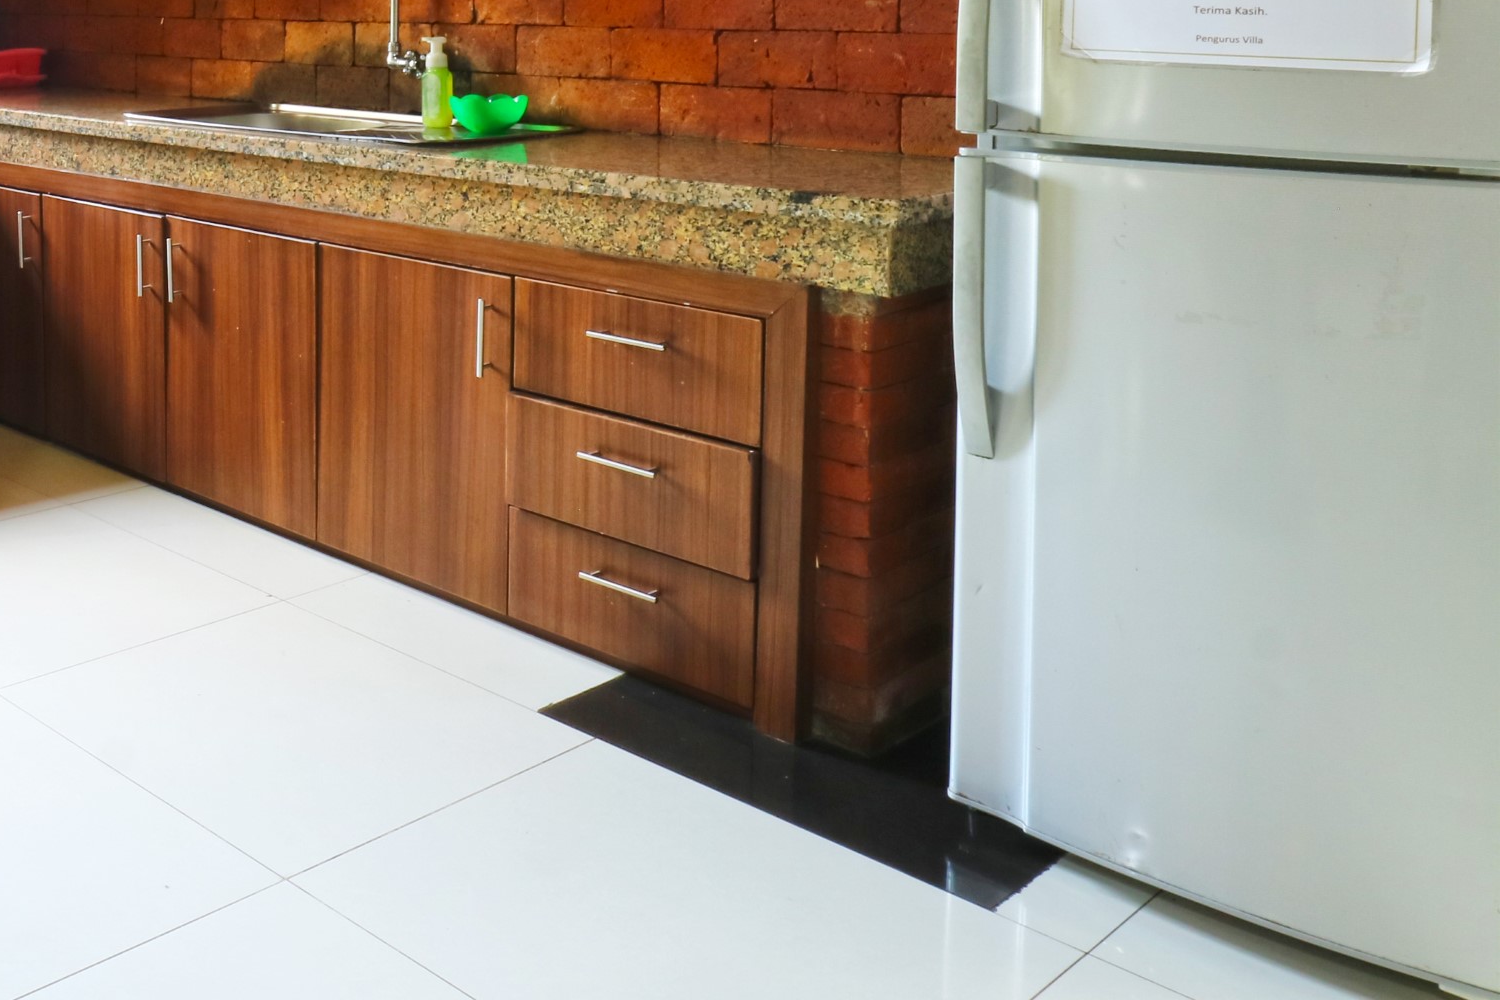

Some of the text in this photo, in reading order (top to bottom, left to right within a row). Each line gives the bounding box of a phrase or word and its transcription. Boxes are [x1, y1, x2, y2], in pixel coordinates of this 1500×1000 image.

[1193, 5, 1268, 16] Terima Kasih.
[1195, 34, 1264, 45] Pengurus Villa
